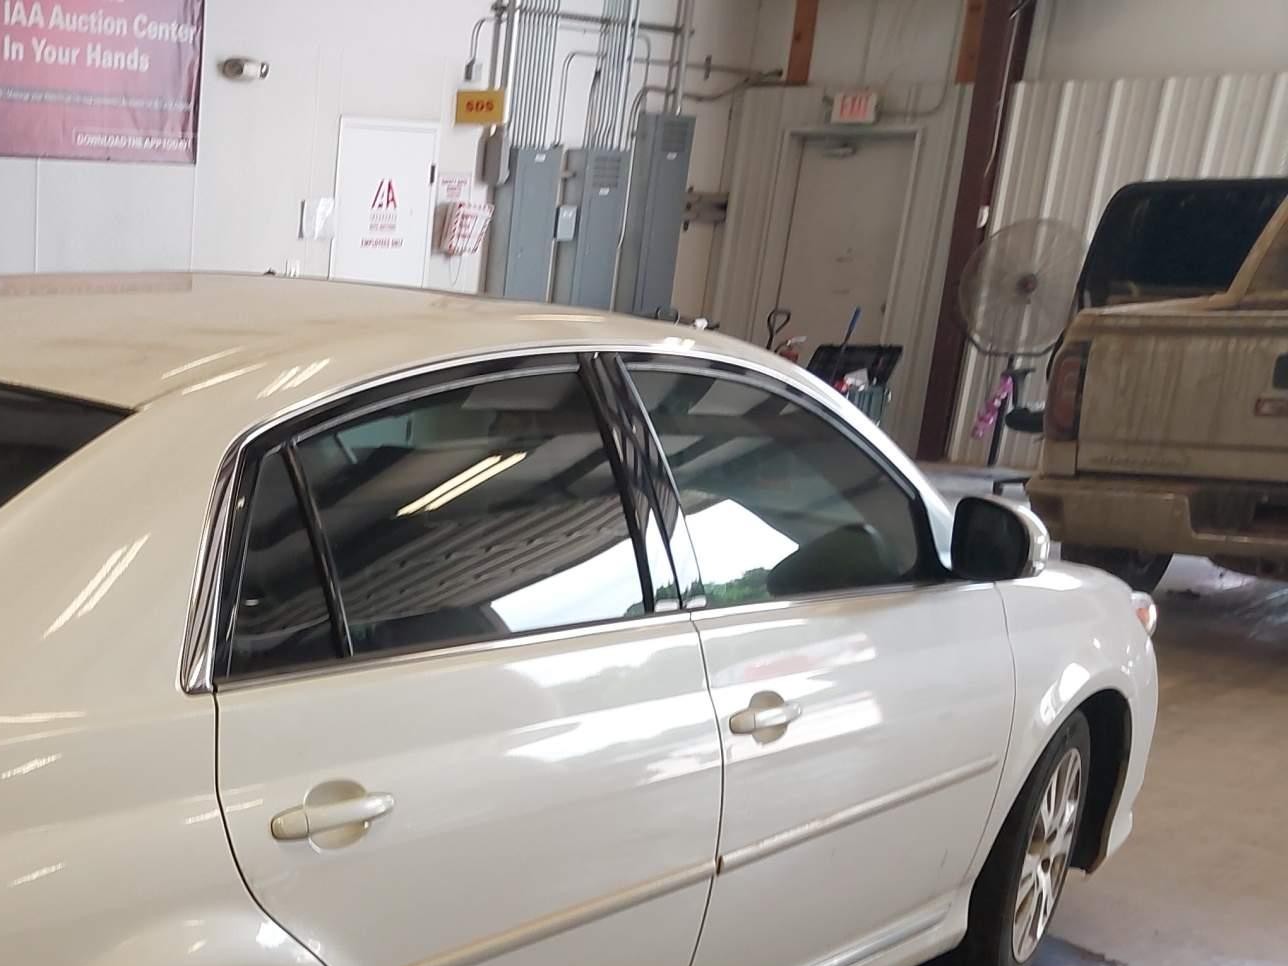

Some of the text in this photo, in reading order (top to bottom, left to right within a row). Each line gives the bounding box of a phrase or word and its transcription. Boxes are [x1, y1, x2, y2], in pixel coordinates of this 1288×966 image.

[3, 2, 44, 28] IAA
[49, 9, 130, 36] Auction
[133, 15, 198, 44] Center
[3, 35, 150, 72] In Your Hands
